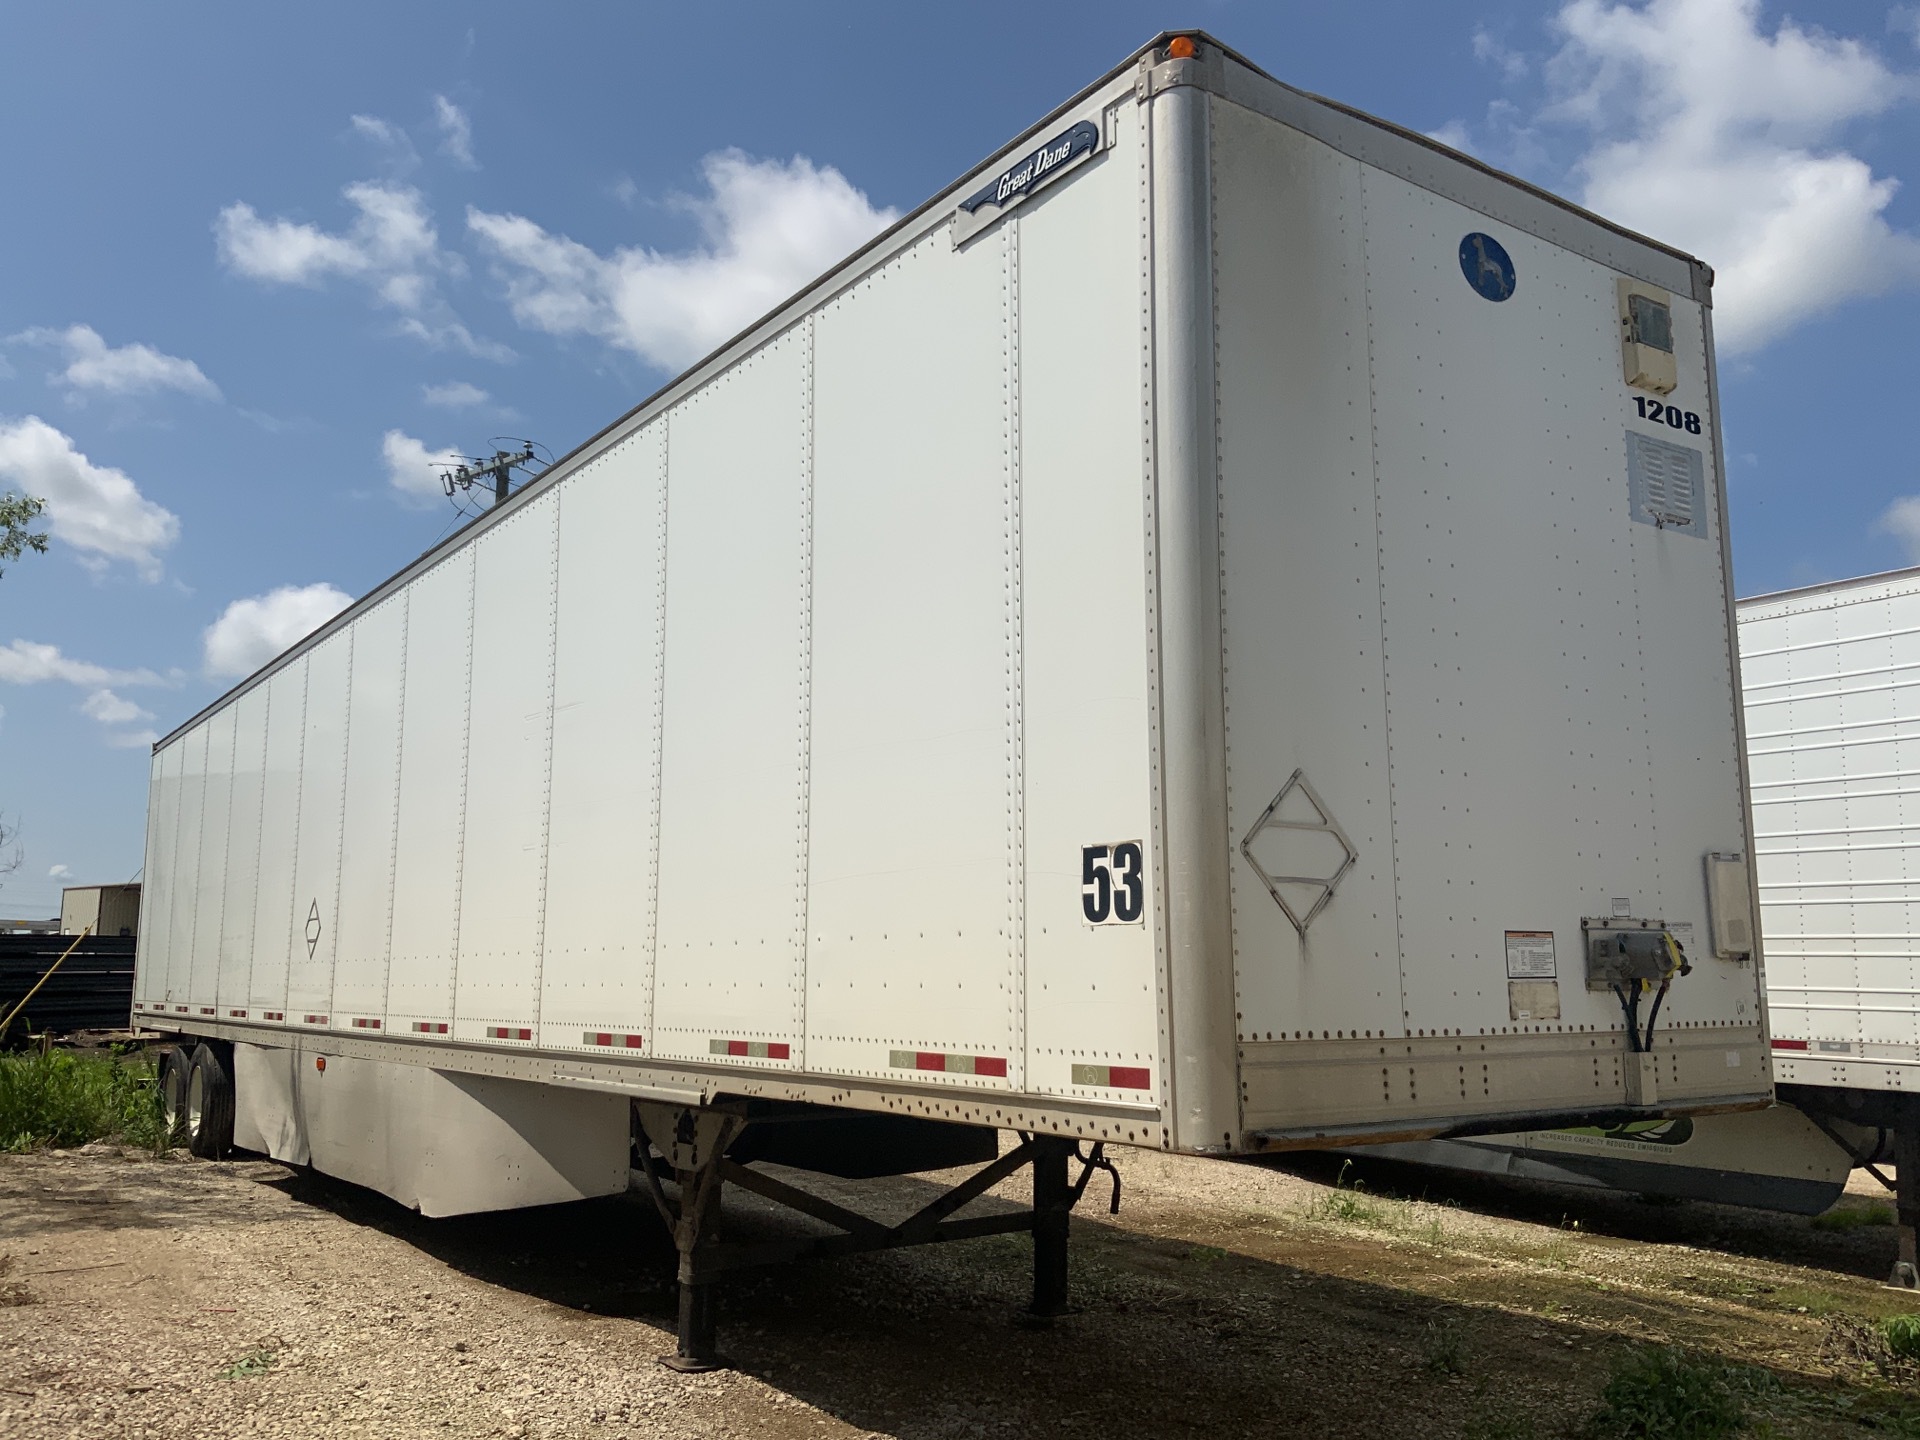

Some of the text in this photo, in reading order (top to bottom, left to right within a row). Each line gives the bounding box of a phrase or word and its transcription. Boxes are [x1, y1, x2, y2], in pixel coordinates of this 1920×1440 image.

[997, 141, 1071, 200] Great Dane
[1632, 396, 1702, 435] 1208
[1082, 843, 1143, 922] 53
[1539, 1132, 1673, 1154] INCREASED CAPACITY REDUCED EMISSIONS
